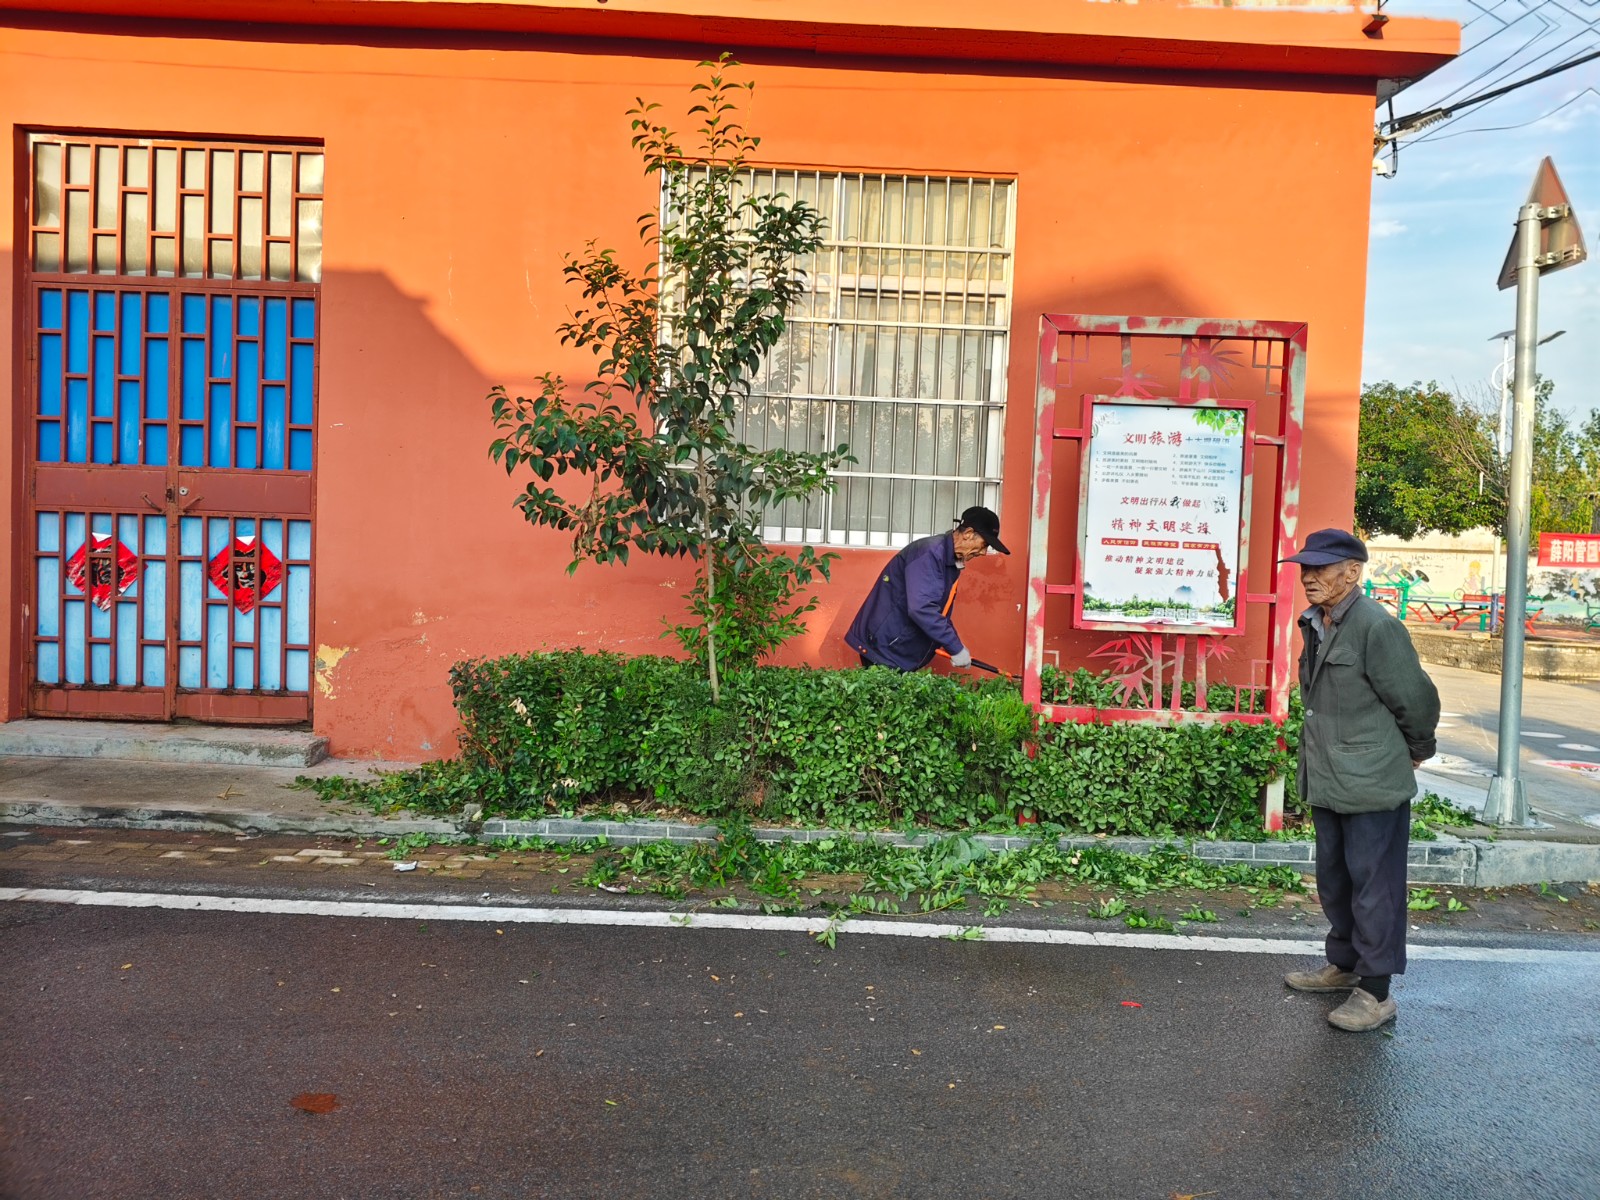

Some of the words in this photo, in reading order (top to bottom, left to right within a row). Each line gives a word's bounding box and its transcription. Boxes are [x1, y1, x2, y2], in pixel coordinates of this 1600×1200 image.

[1123, 431, 1183, 447] 文明旅游
[1120, 496, 1201, 508] 文明出行从我做起
[1111, 518, 1211, 535] 精神文明建设
